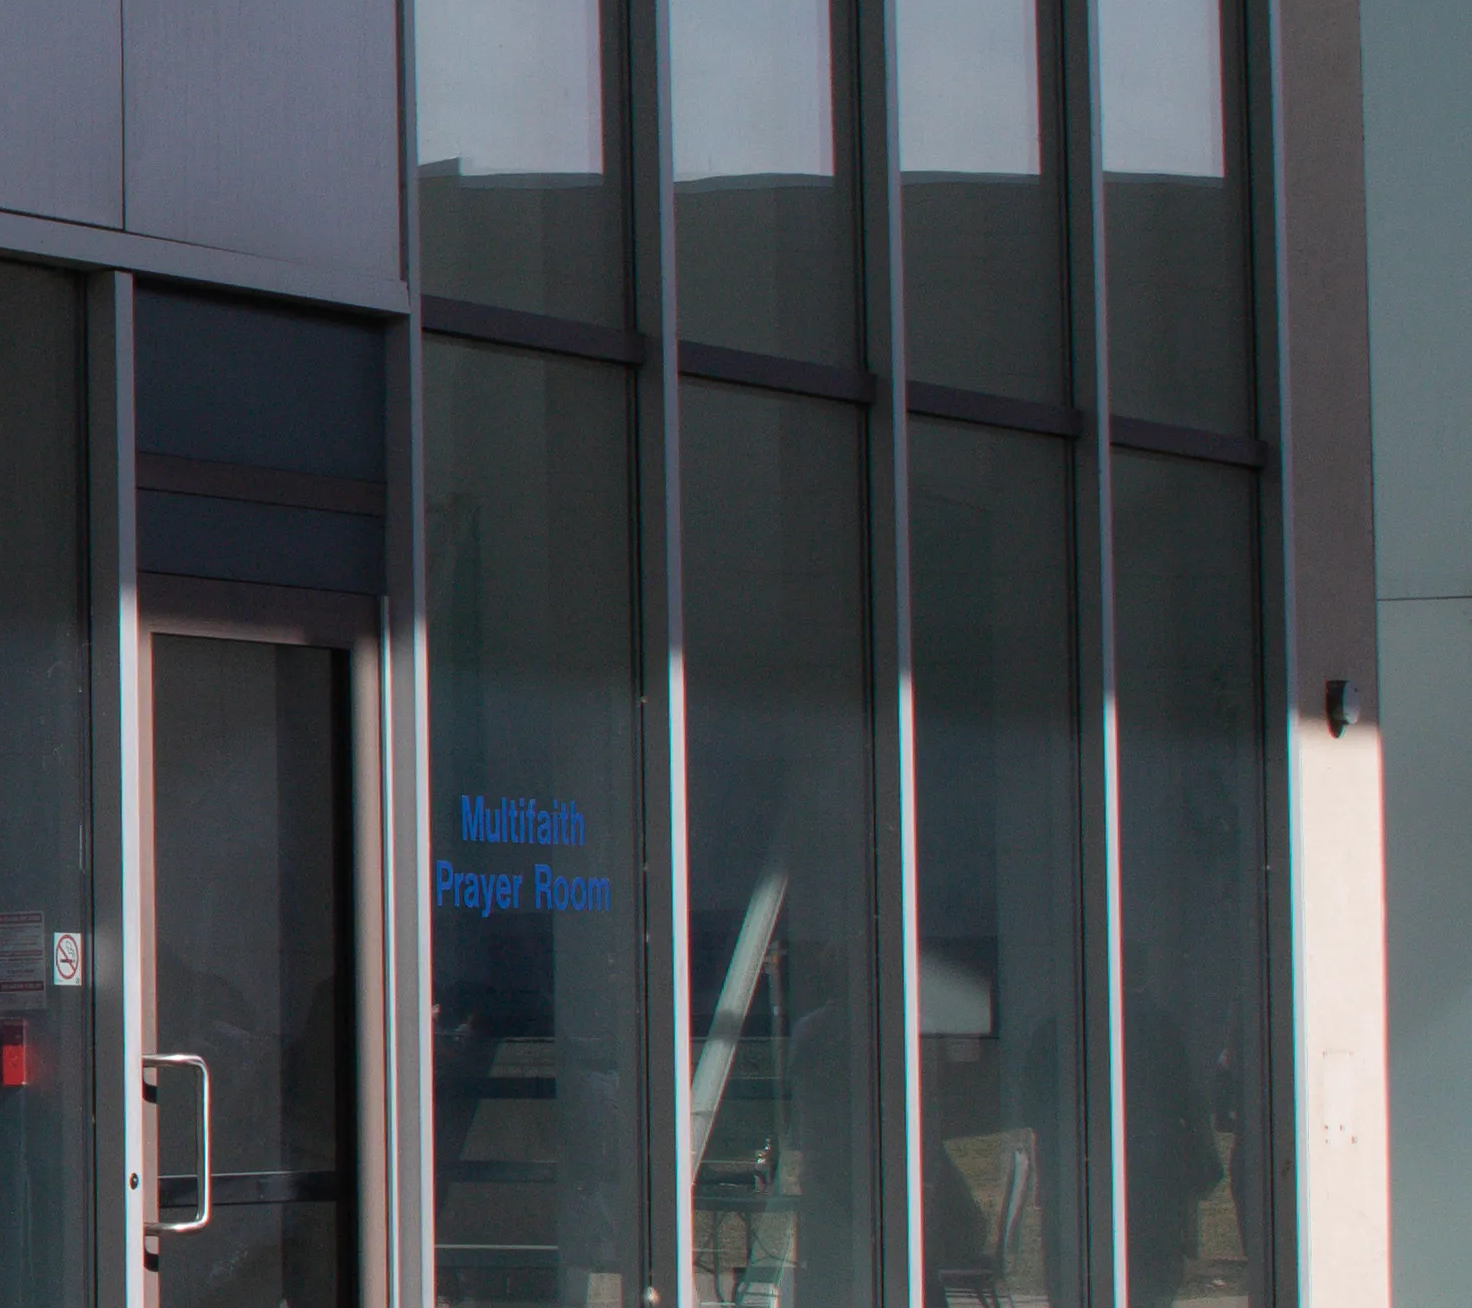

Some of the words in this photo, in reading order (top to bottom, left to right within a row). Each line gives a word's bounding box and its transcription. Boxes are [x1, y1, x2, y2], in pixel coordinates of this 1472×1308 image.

[461, 795, 586, 846] Multifaith
[436, 860, 523, 917] Prayer
[535, 864, 611, 911] Room
